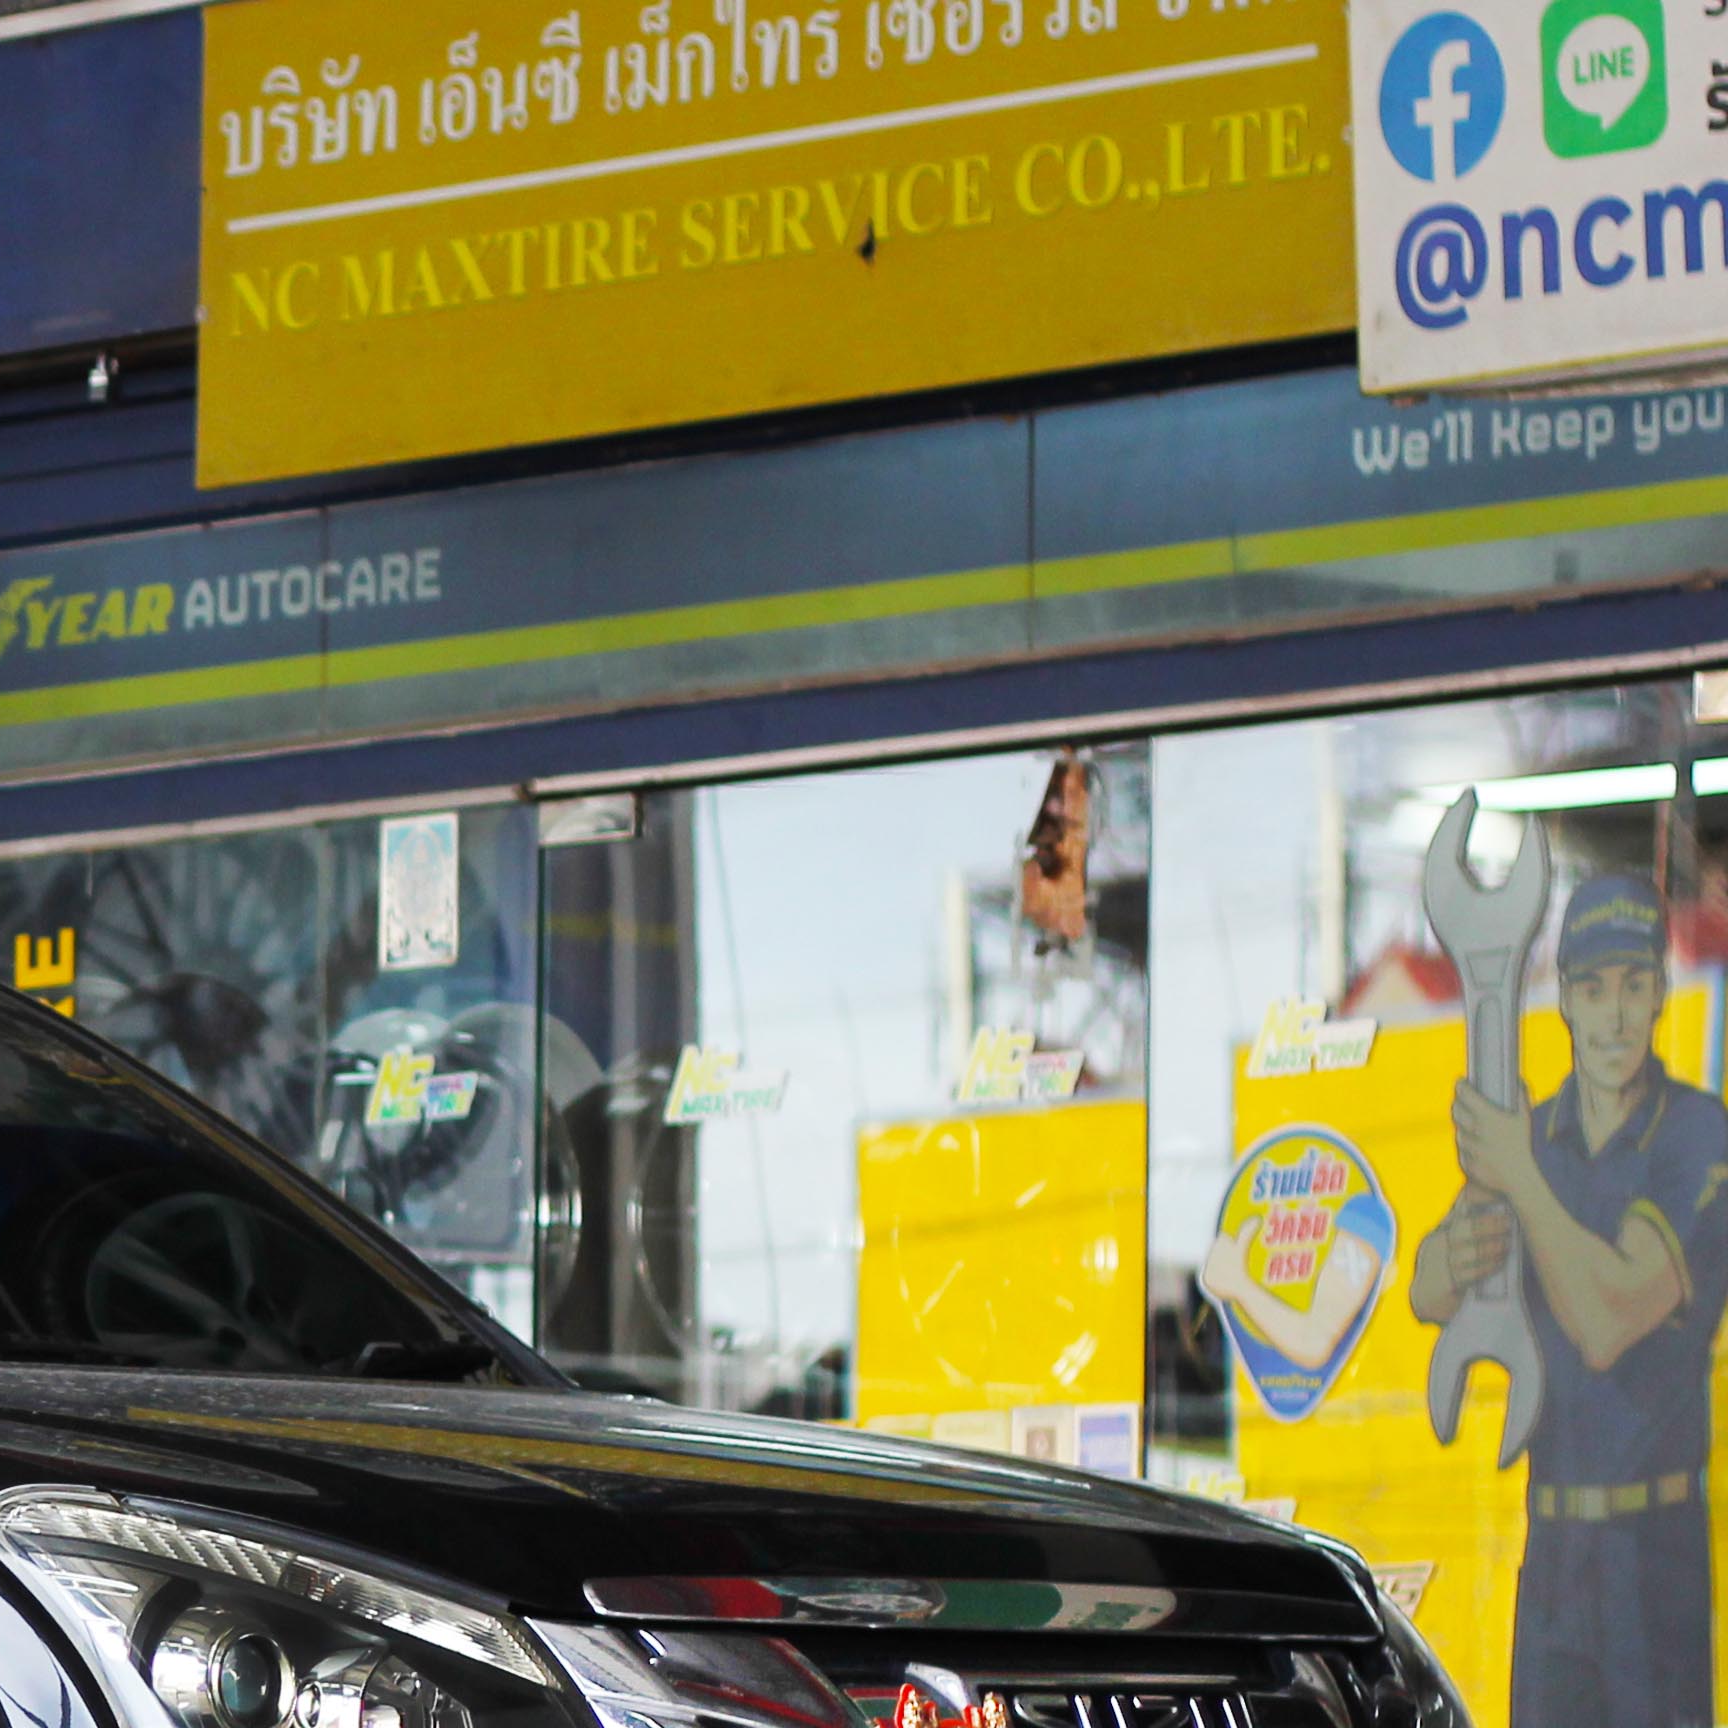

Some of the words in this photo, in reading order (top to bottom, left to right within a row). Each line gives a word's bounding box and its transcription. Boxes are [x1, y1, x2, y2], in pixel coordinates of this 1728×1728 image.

[221, 55, 399, 178] บริษัท
[418, 10, 584, 145] เอ็นซี
[1573, 47, 1635, 84] LINE
[231, 262, 321, 337] NC
[340, 207, 661, 323] MAXTIRE
[679, 153, 995, 270] SERVICE
[1353, 407, 1474, 476] We'll
[1632, 390, 1725, 454] you
[182, 547, 444, 632] AUTOCARE
